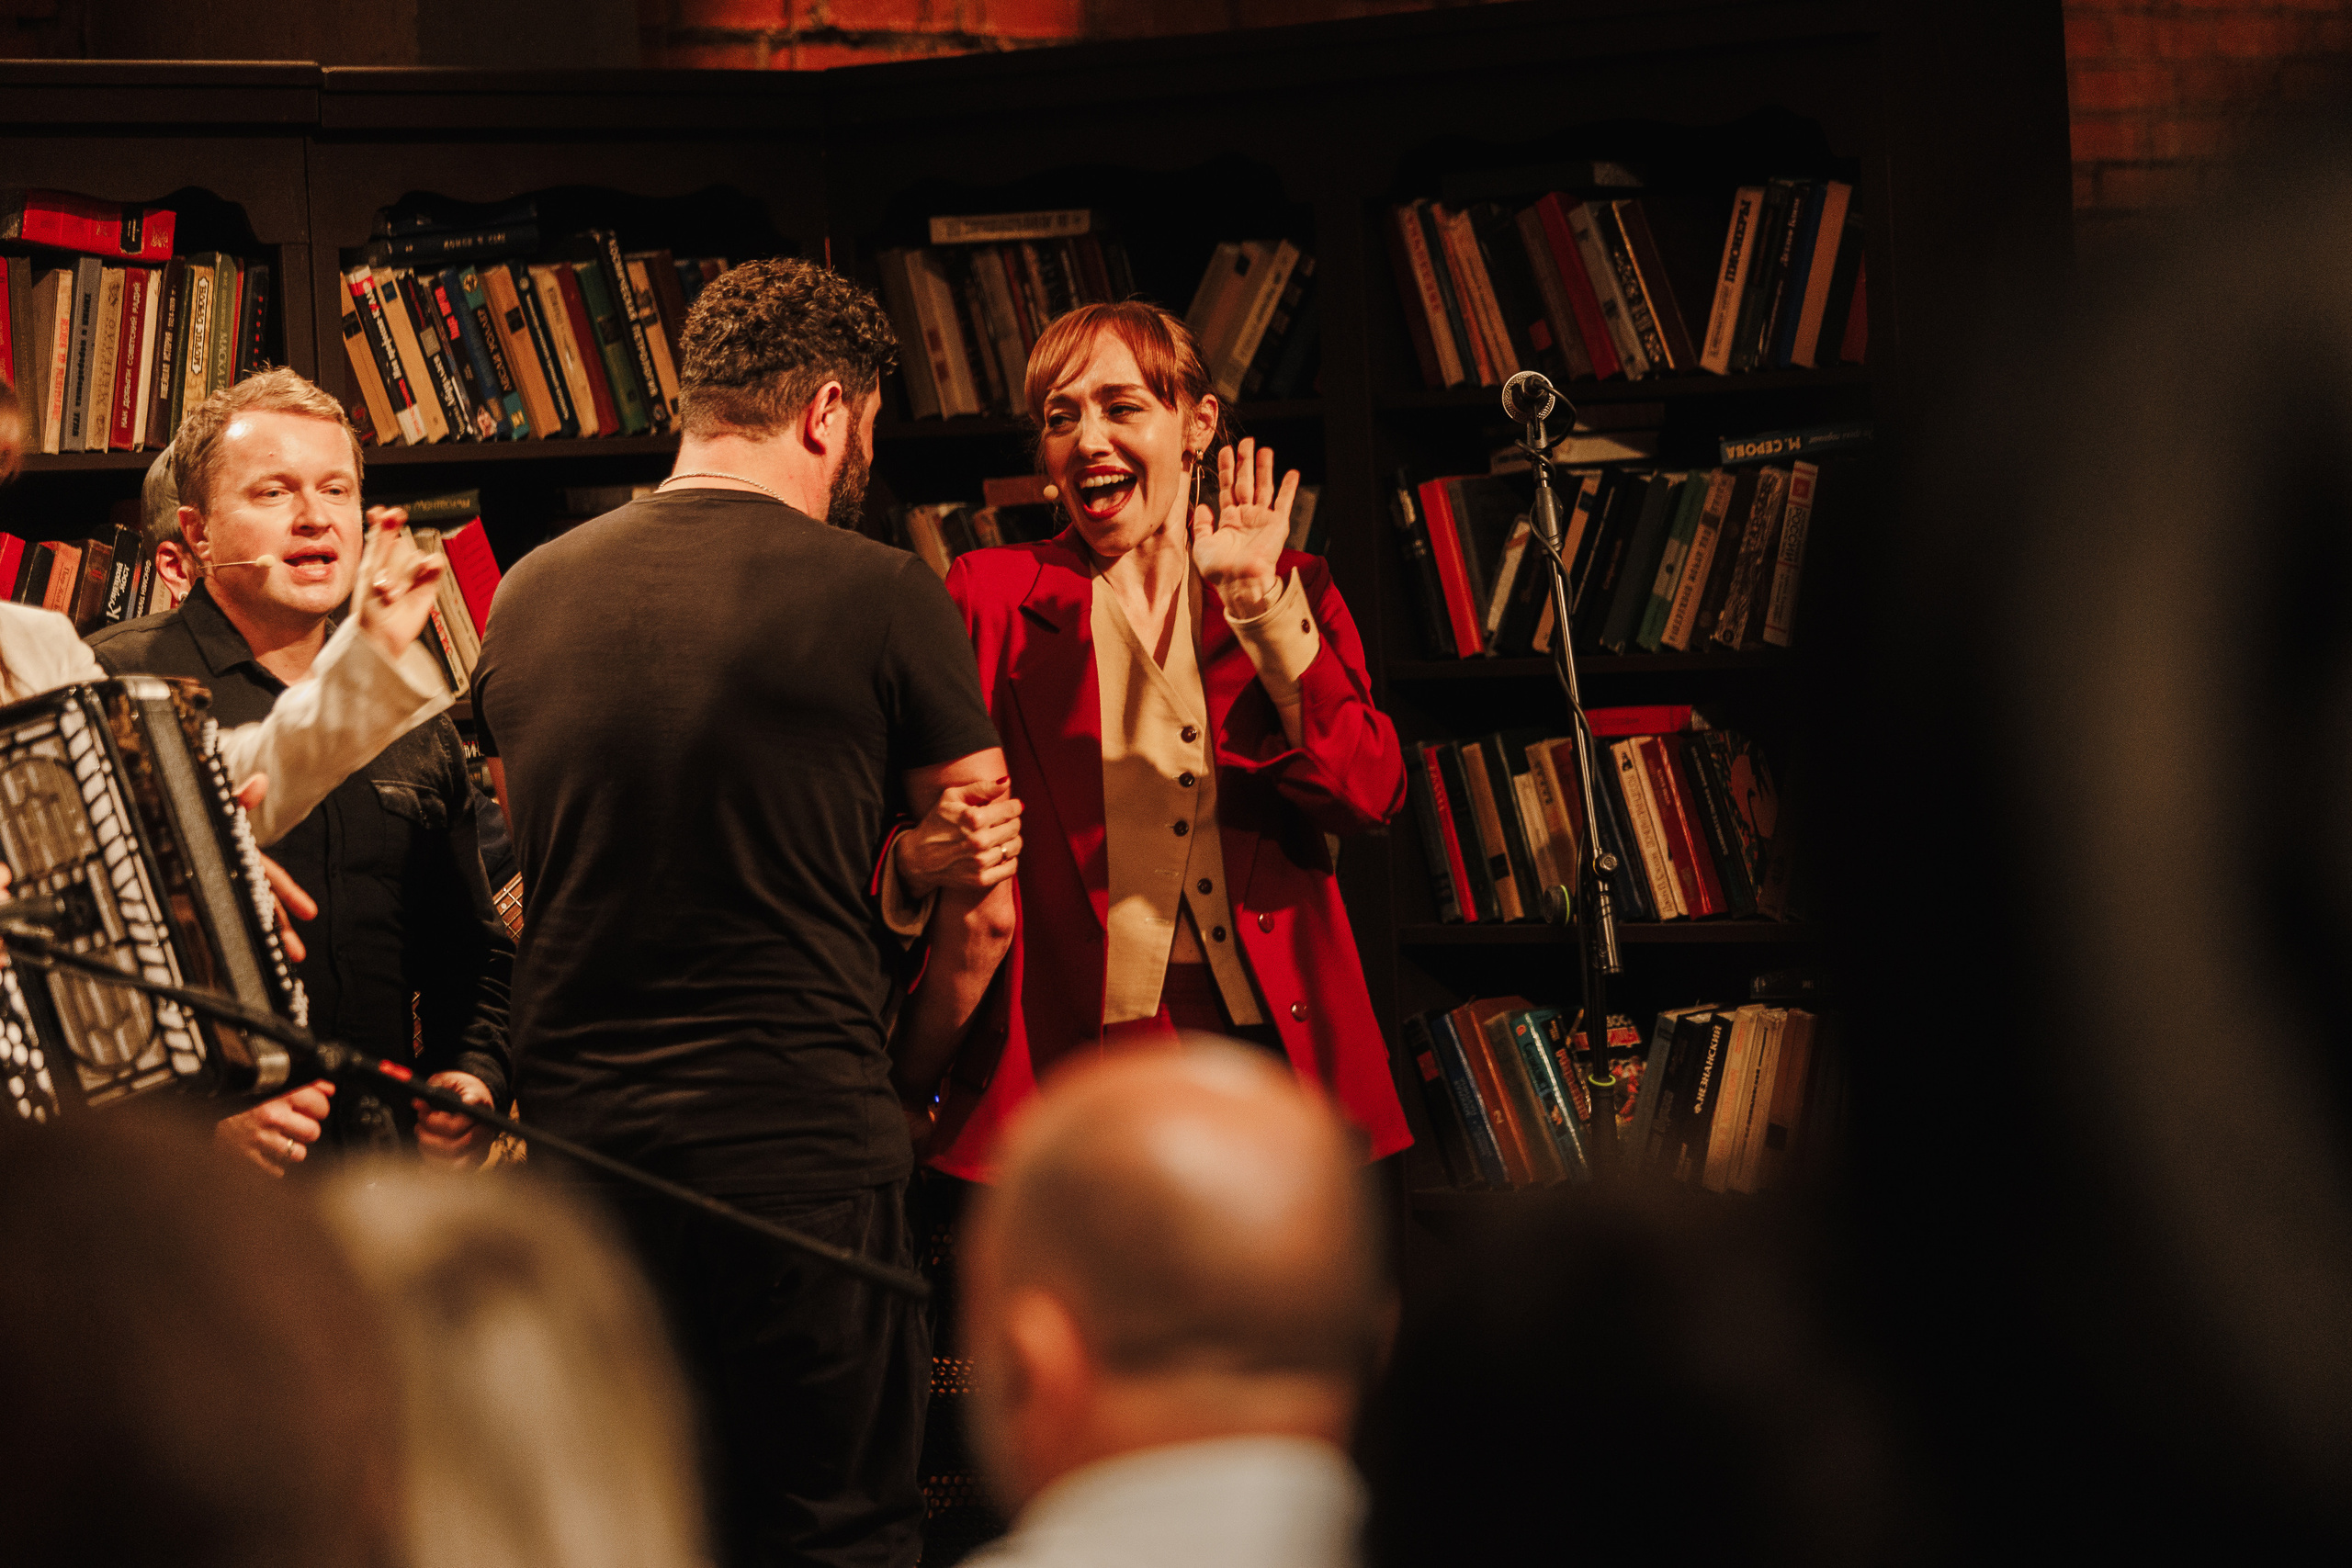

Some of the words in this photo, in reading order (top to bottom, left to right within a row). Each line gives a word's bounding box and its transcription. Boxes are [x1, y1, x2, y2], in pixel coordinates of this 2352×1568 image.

[1724, 198, 1752, 283] ПИОНЕРЫ
[130, 281, 141, 312] РАДИЙ
[606, 238, 639, 321] КОСМИЧЕСКАЯ
[632, 322, 660, 398] ПЕТРОЛОГИЯ
[126, 315, 137, 366] СОВЕТСКИЙ
[216, 332, 228, 376] МАСКА
[120, 410, 129, 428] КАК
[1783, 506, 1802, 562] РОССИИ
[1494, 1110, 1504, 1124] 2
